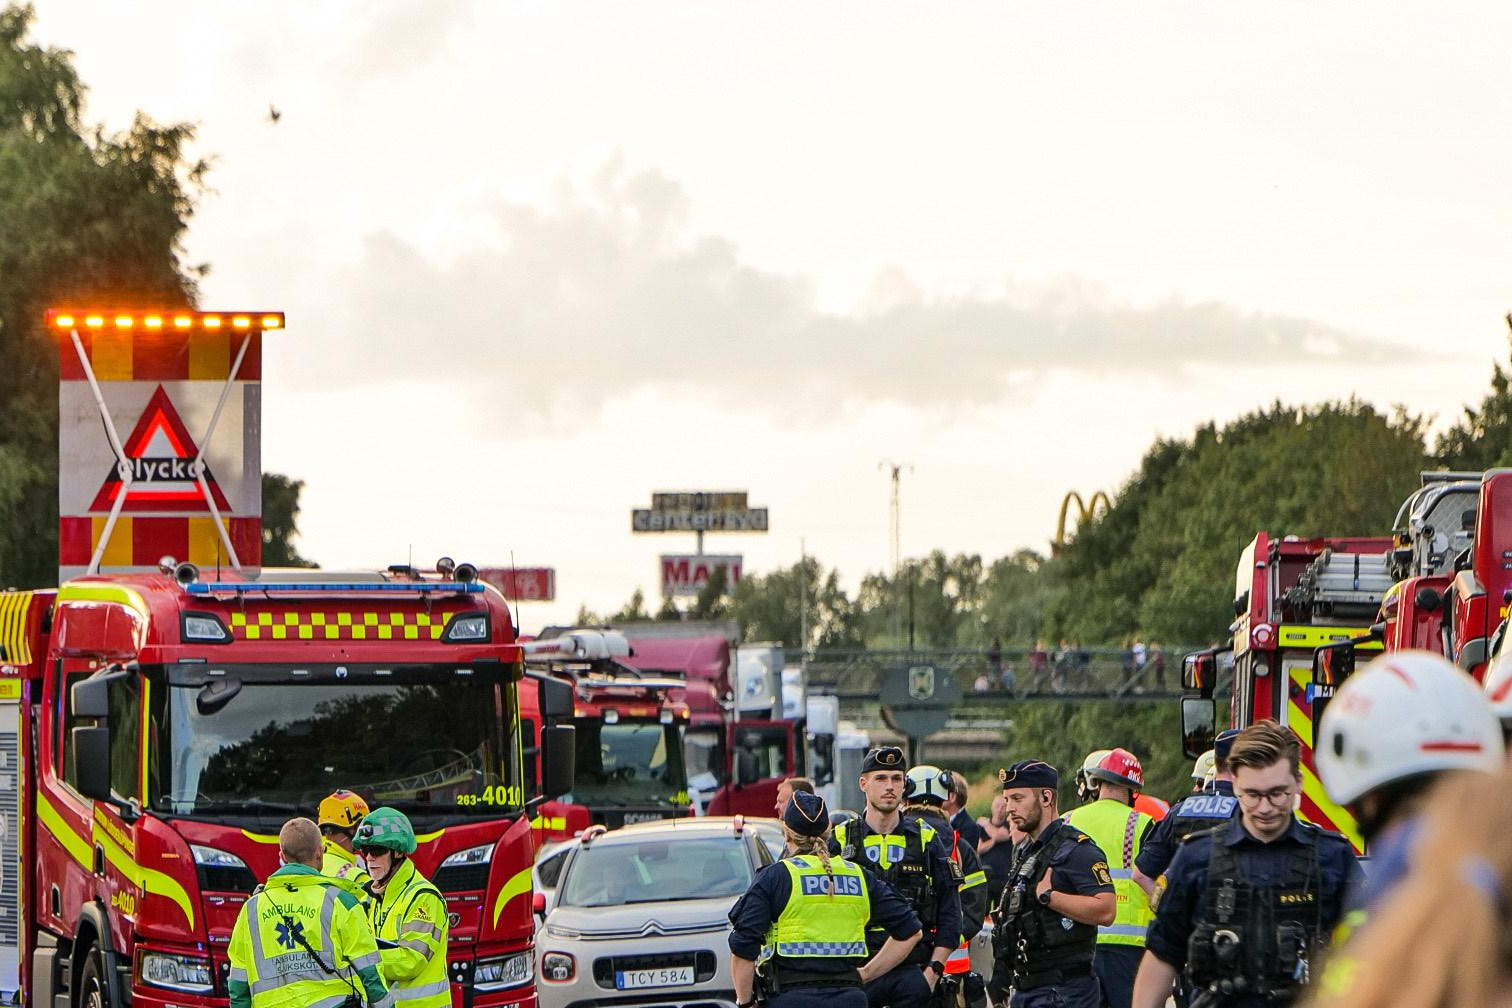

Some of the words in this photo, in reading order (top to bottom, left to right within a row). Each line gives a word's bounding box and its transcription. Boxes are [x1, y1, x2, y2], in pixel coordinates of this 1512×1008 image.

[664, 559, 741, 585] MAI
[457, 785, 521, 807] 263-4010
[1180, 798, 1233, 814] POLIS
[865, 845, 905, 863] OLI
[806, 876, 859, 894] POLIS
[261, 903, 317, 922] AMBULANS
[275, 953, 321, 966] AMBULAN
[629, 972, 657, 985] TCY
[660, 969, 688, 983] 584
